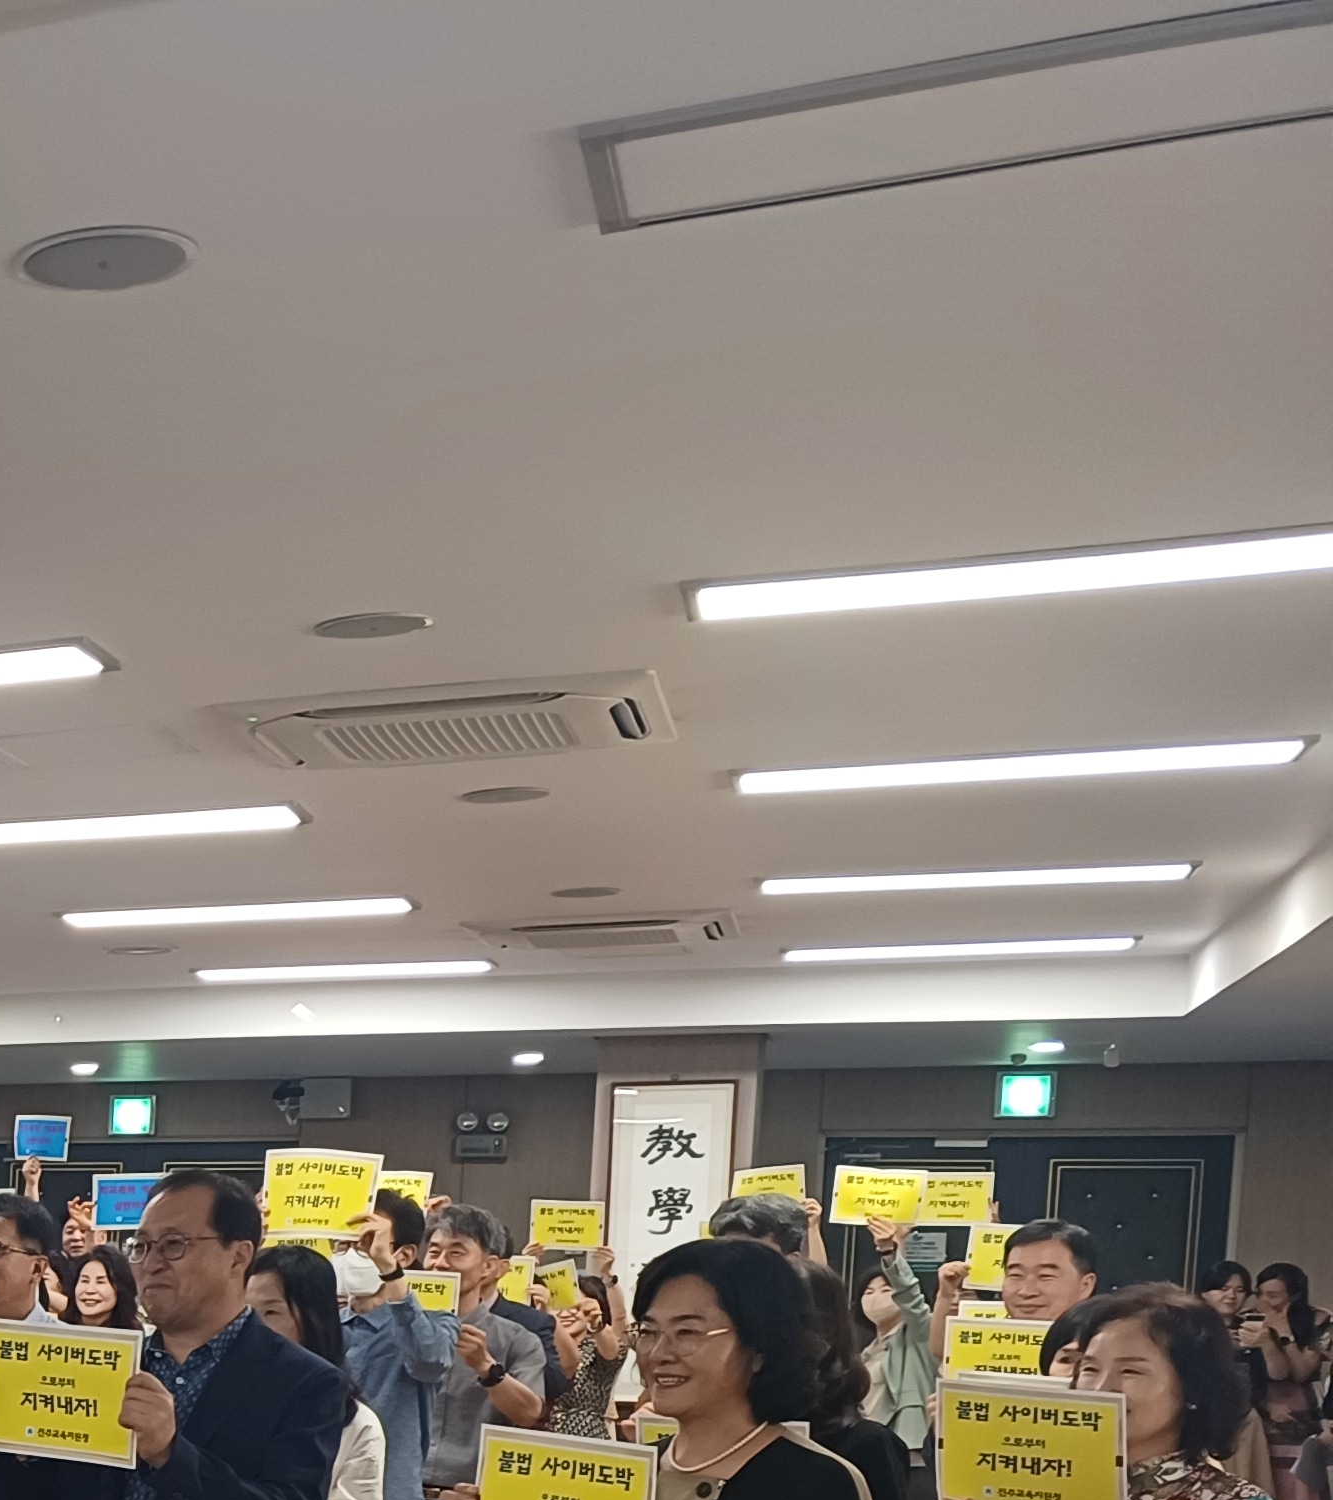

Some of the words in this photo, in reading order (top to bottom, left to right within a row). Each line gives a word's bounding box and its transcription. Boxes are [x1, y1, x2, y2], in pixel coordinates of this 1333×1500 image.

[275, 1163, 294, 1176] 불법
[298, 1162, 365, 1179] 사이버도박
[639, 1124, 706, 1236] 教學
[870, 1176, 916, 1187] 사이버도박
[284, 1195, 340, 1209] 지켜내자!
[407, 1282, 446, 1295] 버도박
[958, 1331, 983, 1344] 불법
[989, 1332, 1043, 1347] 사이버도
[37, 1344, 121, 1371] 사이버도박
[39, 1376, 76, 1388] 으로부터
[20, 1392, 98, 1417] 지켜내자!
[956, 1400, 990, 1422] 불법
[999, 1405, 1103, 1432] 사이버도박
[37, 1428, 89, 1443] 진주교육지원청
[1001, 1436, 1046, 1449] 으로부터
[498, 1450, 532, 1475] 불법
[541, 1457, 635, 1491] 사이버도박
[976, 1453, 1072, 1478] 지켜내자!
